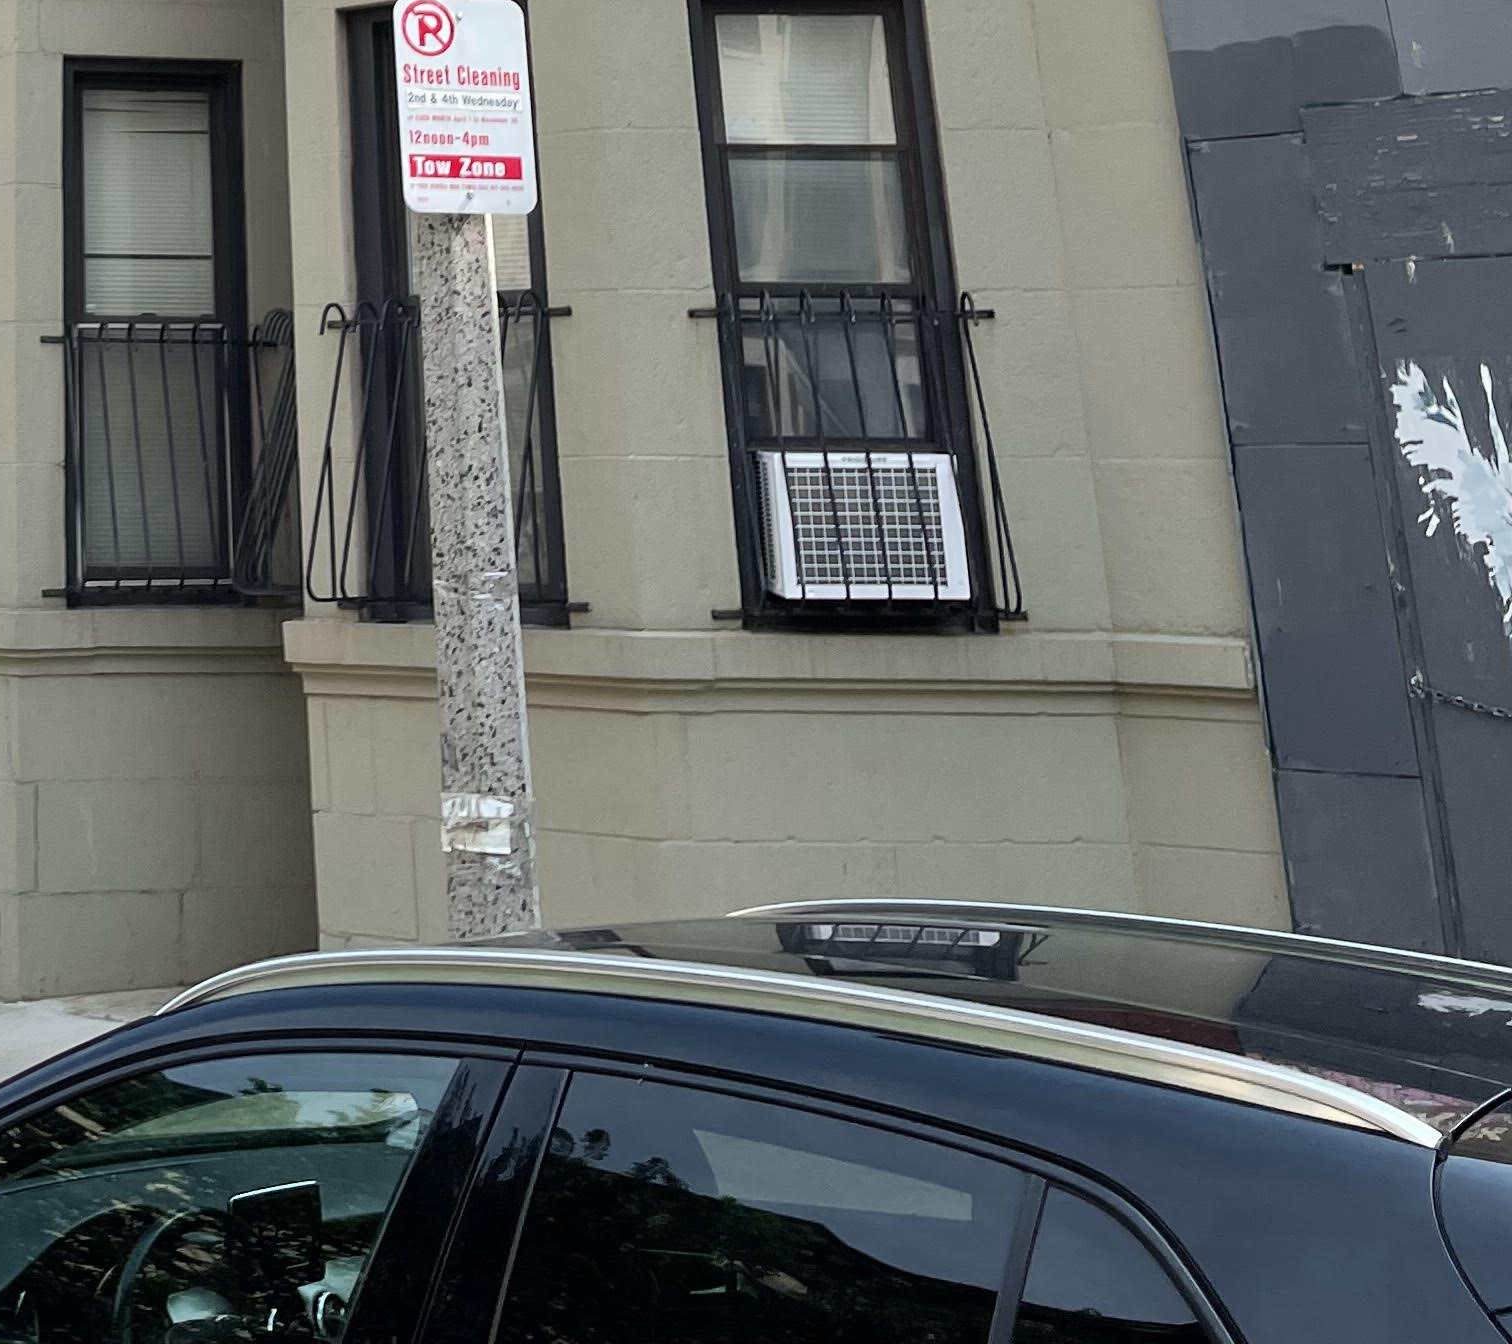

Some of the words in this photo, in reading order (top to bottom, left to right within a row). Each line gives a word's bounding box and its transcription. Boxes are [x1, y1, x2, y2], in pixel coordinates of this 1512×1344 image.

[403, 63, 450, 85] Street
[457, 64, 520, 91] Cleaning
[408, 91, 426, 104] 2nd
[430, 93, 438, 105] &
[441, 93, 459, 105] 4th
[462, 94, 519, 111] Wednesday
[409, 130, 490, 148] 12noon-4pm
[413, 156, 452, 177] Tow
[459, 157, 506, 178] Zone
